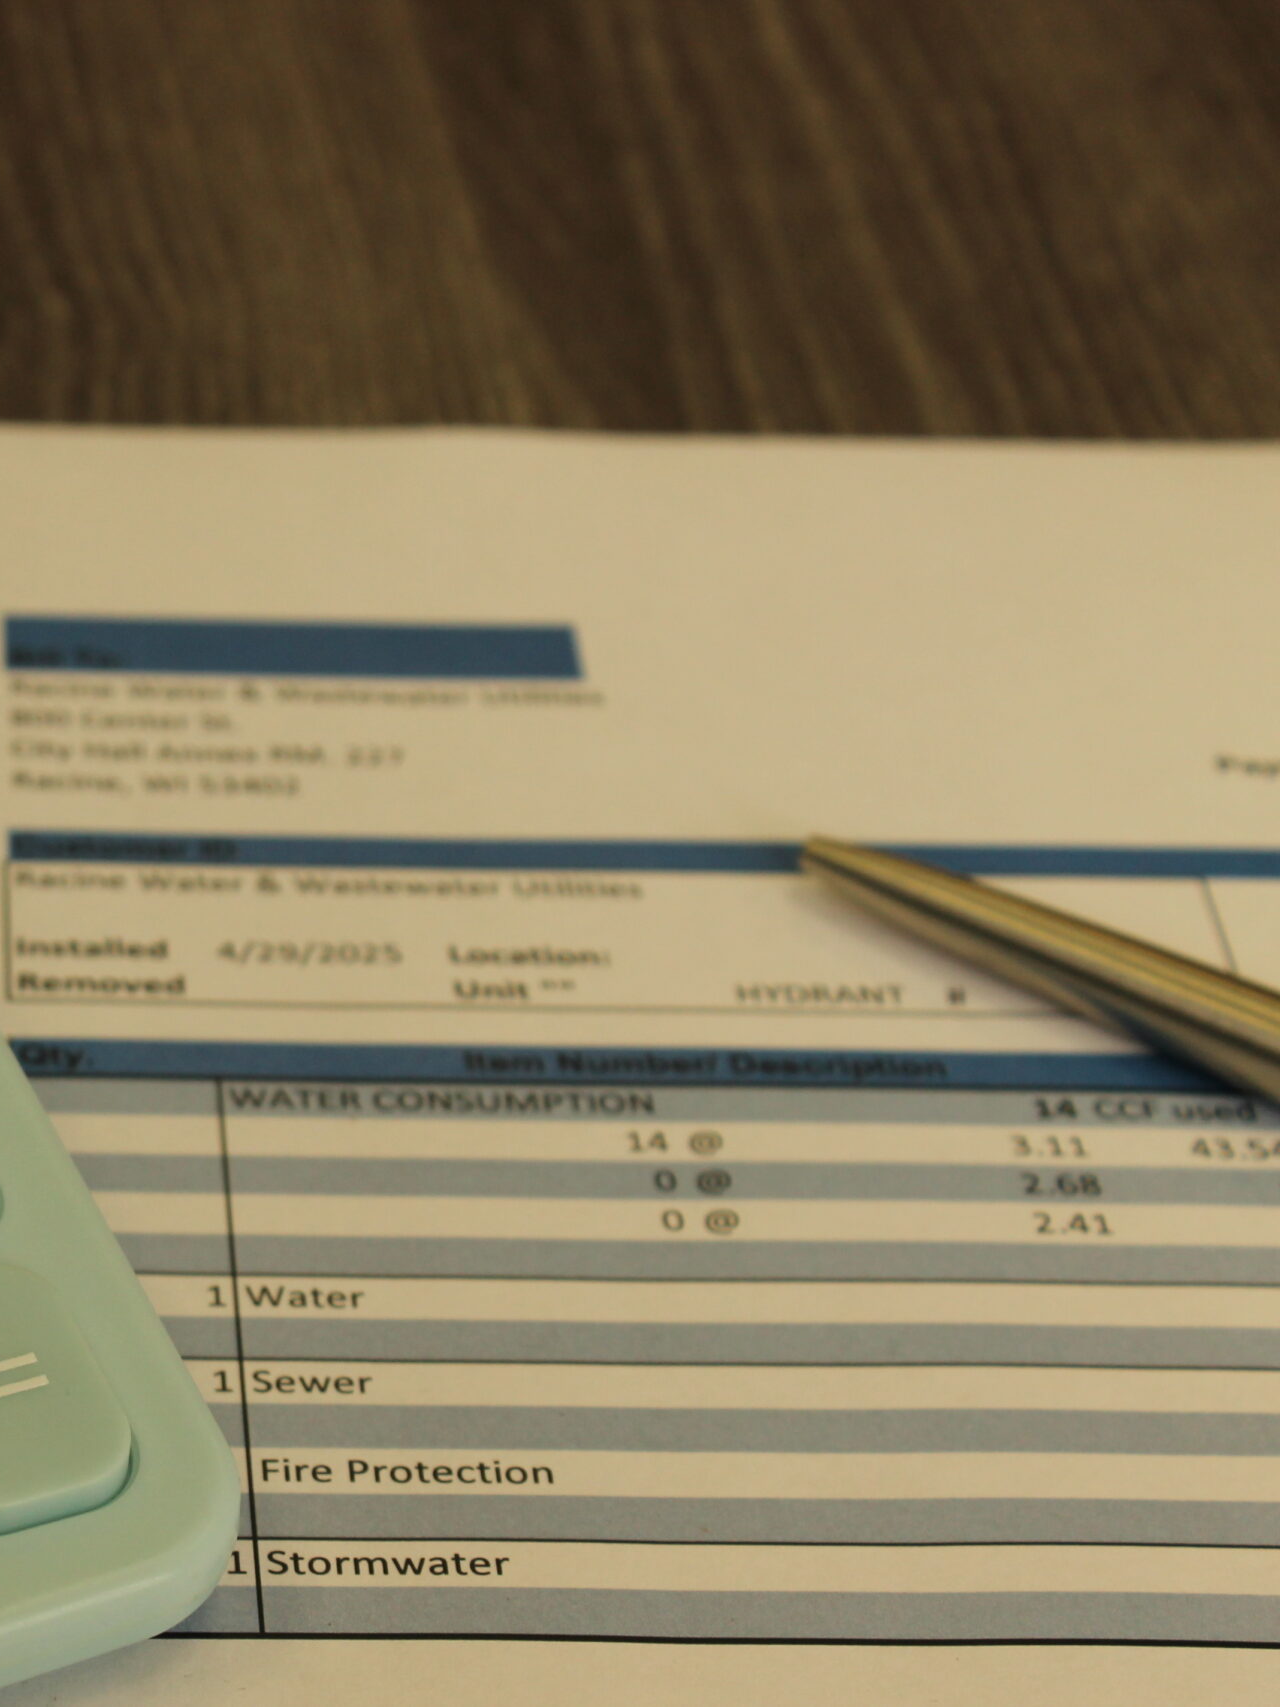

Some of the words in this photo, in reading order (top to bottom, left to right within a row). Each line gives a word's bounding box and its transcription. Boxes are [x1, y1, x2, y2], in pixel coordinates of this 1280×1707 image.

[14, 869, 126, 891] Racine
[138, 872, 243, 894] Water
[256, 873, 281, 894] &
[295, 875, 499, 899] Wastewater
[511, 880, 644, 900] Utilities
[16, 937, 170, 960] Installed
[216, 940, 404, 967] 4/29/2025
[447, 944, 612, 967] Location:
[17, 972, 187, 995] Removed
[452, 979, 531, 1002] Unit
[734, 984, 904, 1005] HYDRANT
[19, 1042, 95, 1072] Qty.
[464, 1050, 546, 1074] Item
[728, 1053, 949, 1082] Description
[228, 1087, 363, 1113] WATER
[374, 1088, 657, 1117] CONSUMPTION
[1035, 1097, 1080, 1122] 14
[1093, 1098, 1159, 1122] CCF
[1173, 1098, 1261, 1124] used
[628, 1131, 669, 1154] 14
[689, 1131, 725, 1156] @
[1013, 1135, 1092, 1159] 3.11
[654, 1170, 677, 1194] 0
[695, 1170, 734, 1196] @
[1022, 1171, 1104, 1197] 2.68
[662, 1209, 686, 1233] 0
[704, 1209, 741, 1235] @
[1033, 1211, 1117, 1237] 2.41
[208, 1285, 227, 1307] 1
[245, 1285, 366, 1309] Water
[214, 1370, 233, 1393] 1
[252, 1370, 374, 1395] Sewer
[261, 1459, 334, 1483] Fire
[347, 1460, 556, 1485] Protection
[227, 1551, 247, 1575] 1
[267, 1551, 510, 1577] Stormwater
